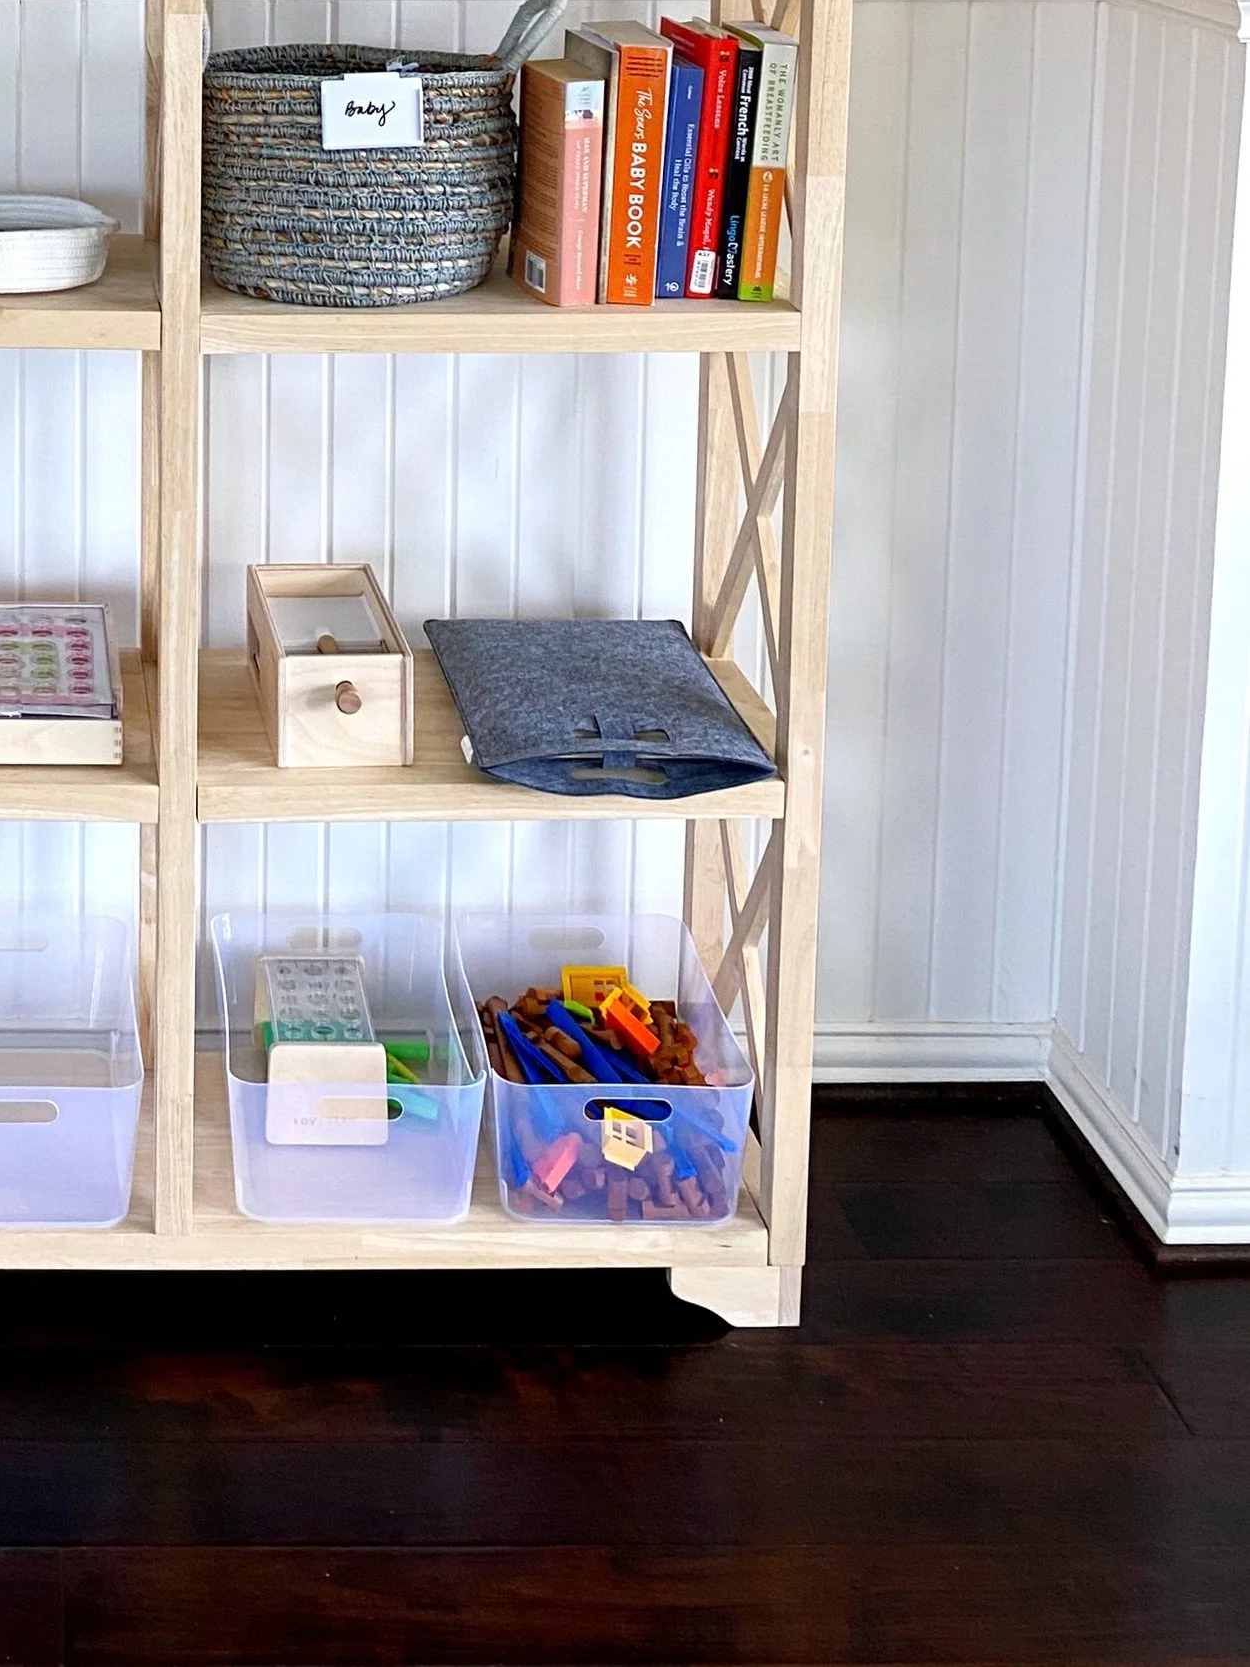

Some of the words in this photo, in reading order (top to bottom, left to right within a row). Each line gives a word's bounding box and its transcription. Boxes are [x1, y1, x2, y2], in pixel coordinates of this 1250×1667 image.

[768, 62, 777, 74] OF
[778, 63, 787, 83] THE
[716, 69, 726, 93] Voice
[634, 86, 653, 108] The
[344, 100, 396, 127] Baby
[713, 93, 724, 128] Lessons
[736, 95, 751, 135] French
[759, 79, 775, 161] BREASTFEEDING
[773, 88, 785, 138] WOMANLY
[631, 107, 652, 140] Sears
[684, 123, 695, 156] Essential
[770, 141, 780, 162] ART
[628, 142, 648, 190] BABY
[672, 159, 682, 176] Heal
[682, 157, 691, 173] Oils
[671, 177, 680, 190] the
[679, 183, 689, 203] Boost
[668, 191, 678, 211] Body
[678, 204, 687, 216] the
[704, 188, 715, 216] Wendy
[624, 193, 644, 248] BOOK
[676, 217, 686, 239] Brain
